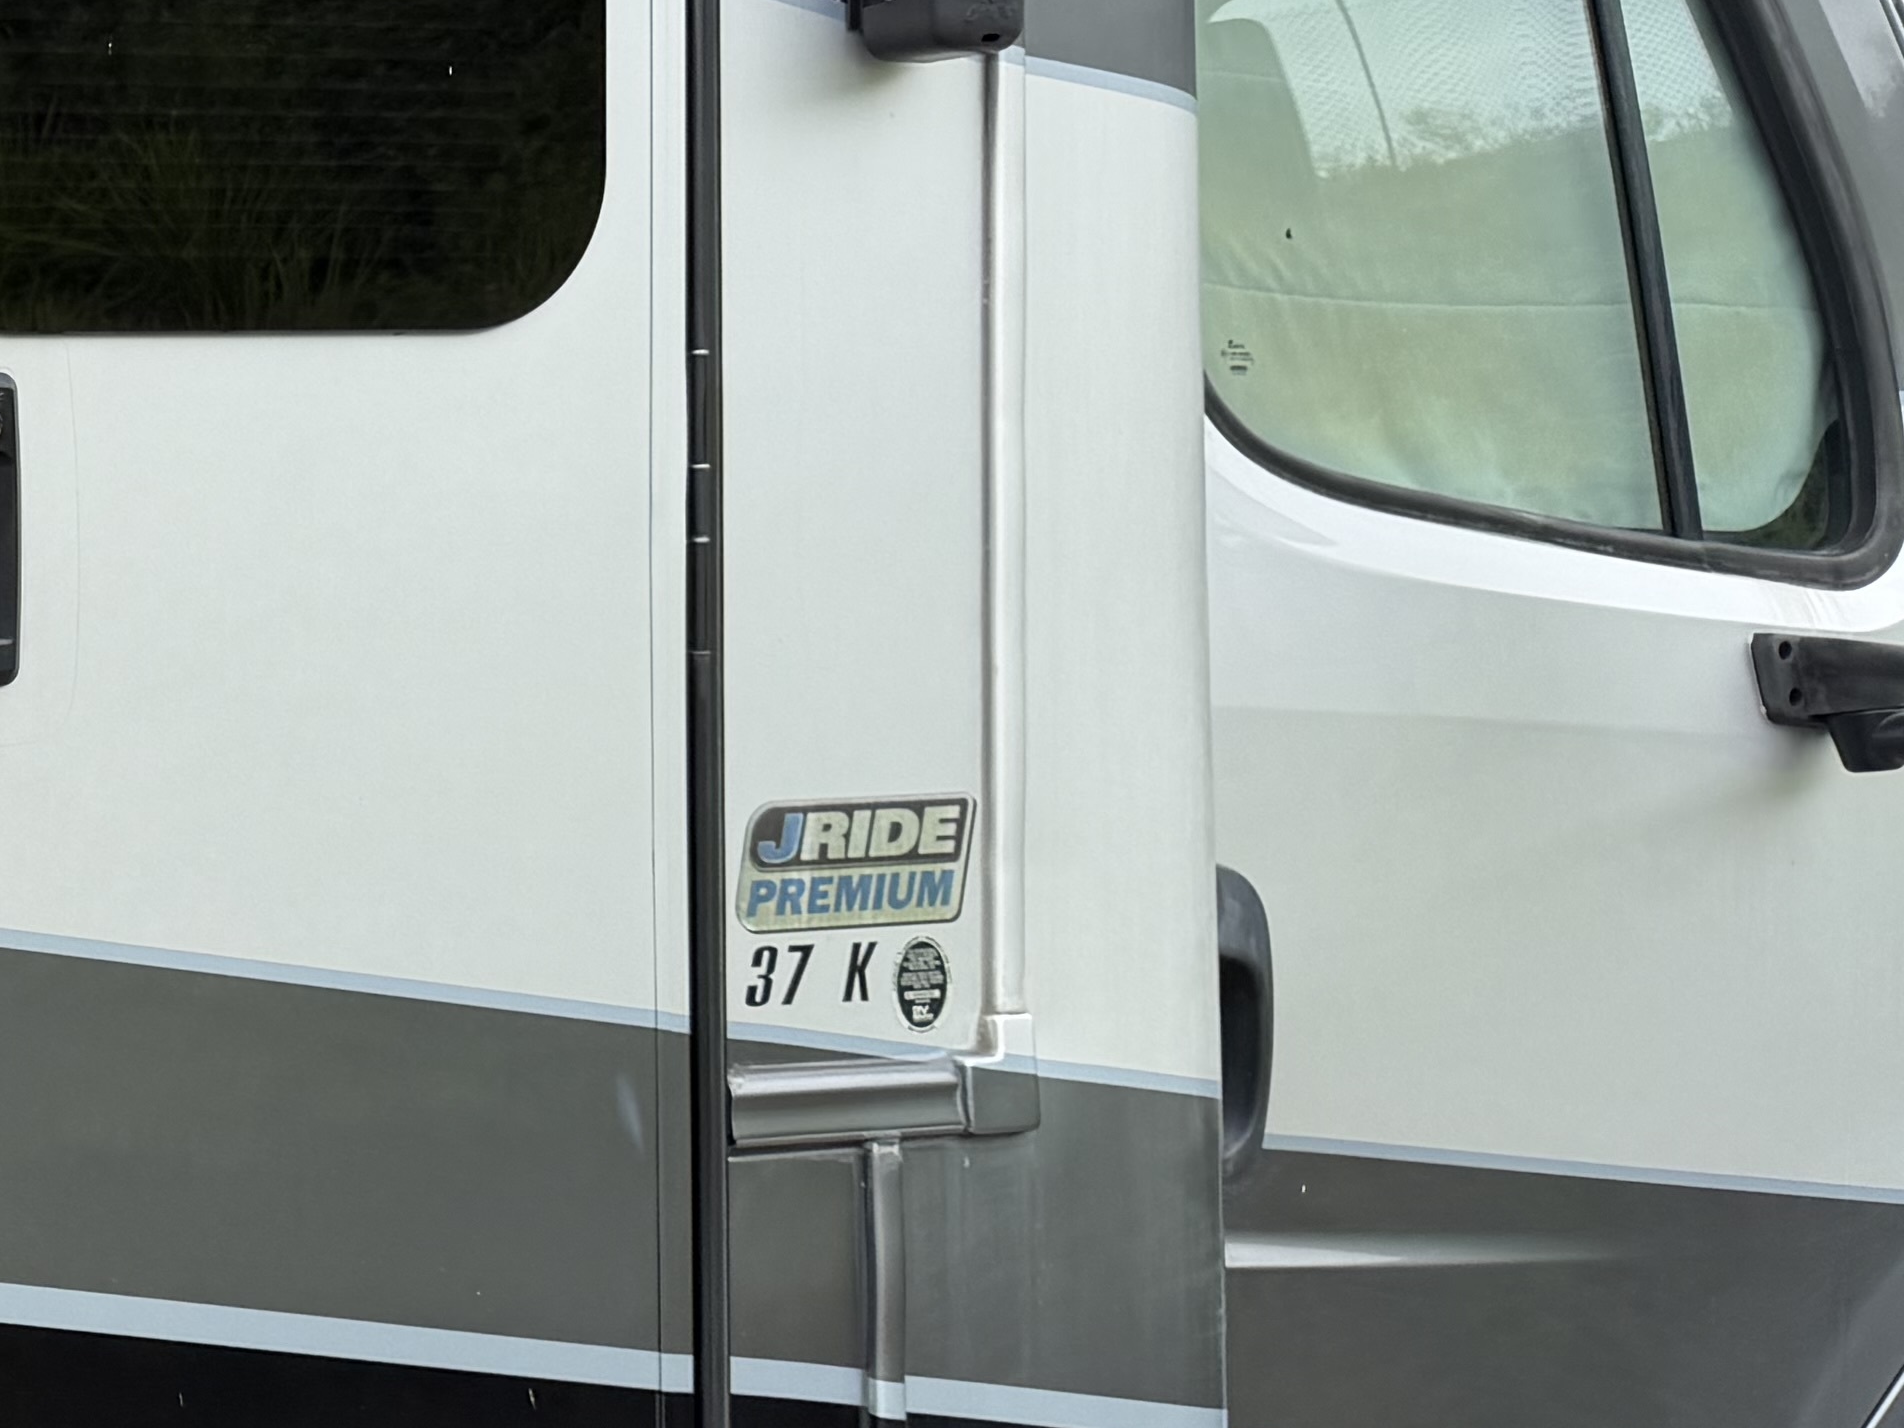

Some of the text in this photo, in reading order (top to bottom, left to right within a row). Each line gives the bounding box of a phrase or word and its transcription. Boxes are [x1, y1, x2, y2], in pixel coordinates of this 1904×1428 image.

[756, 804, 961, 864] JRIDE
[745, 869, 955, 919] PREMIUM
[744, 944, 815, 1008] 37
[841, 940, 879, 1003] K
